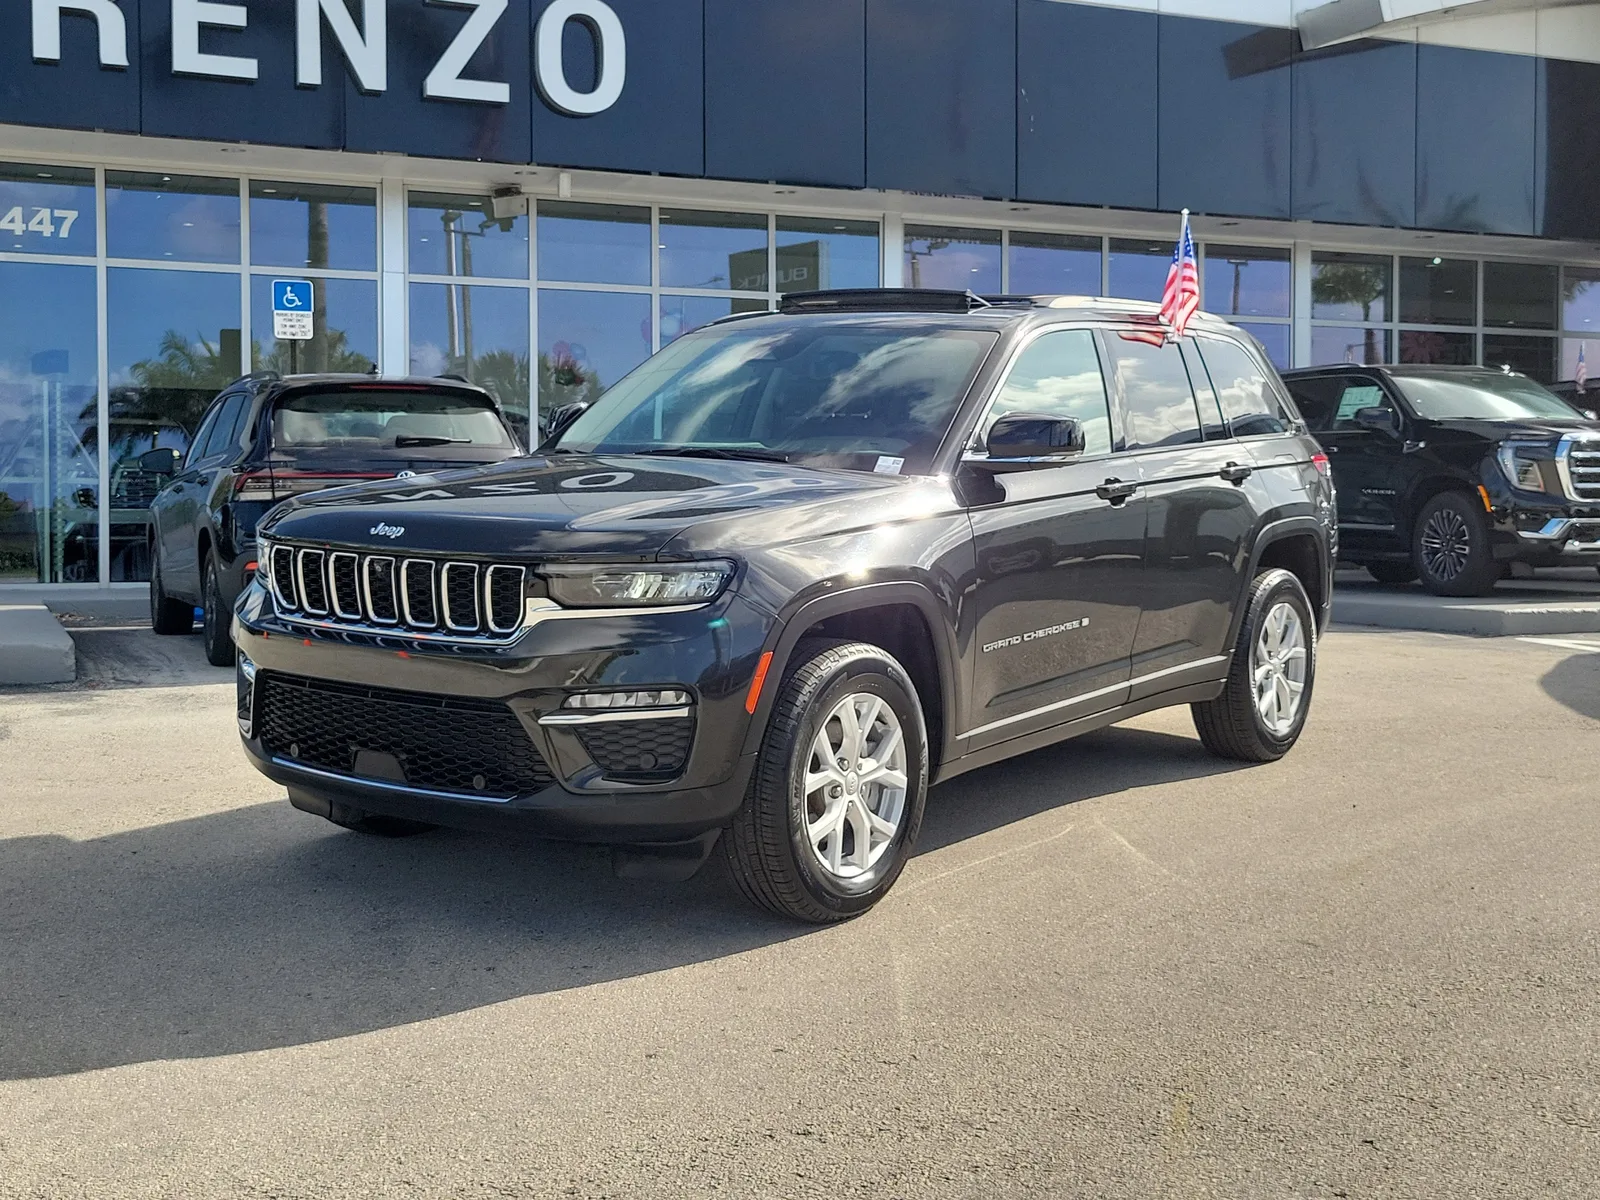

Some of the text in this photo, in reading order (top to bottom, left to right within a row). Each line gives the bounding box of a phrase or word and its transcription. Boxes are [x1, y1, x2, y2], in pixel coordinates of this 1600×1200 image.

[370, 521, 405, 539] Jeep
[983, 619, 1081, 653] GRAND CHEROKEE
